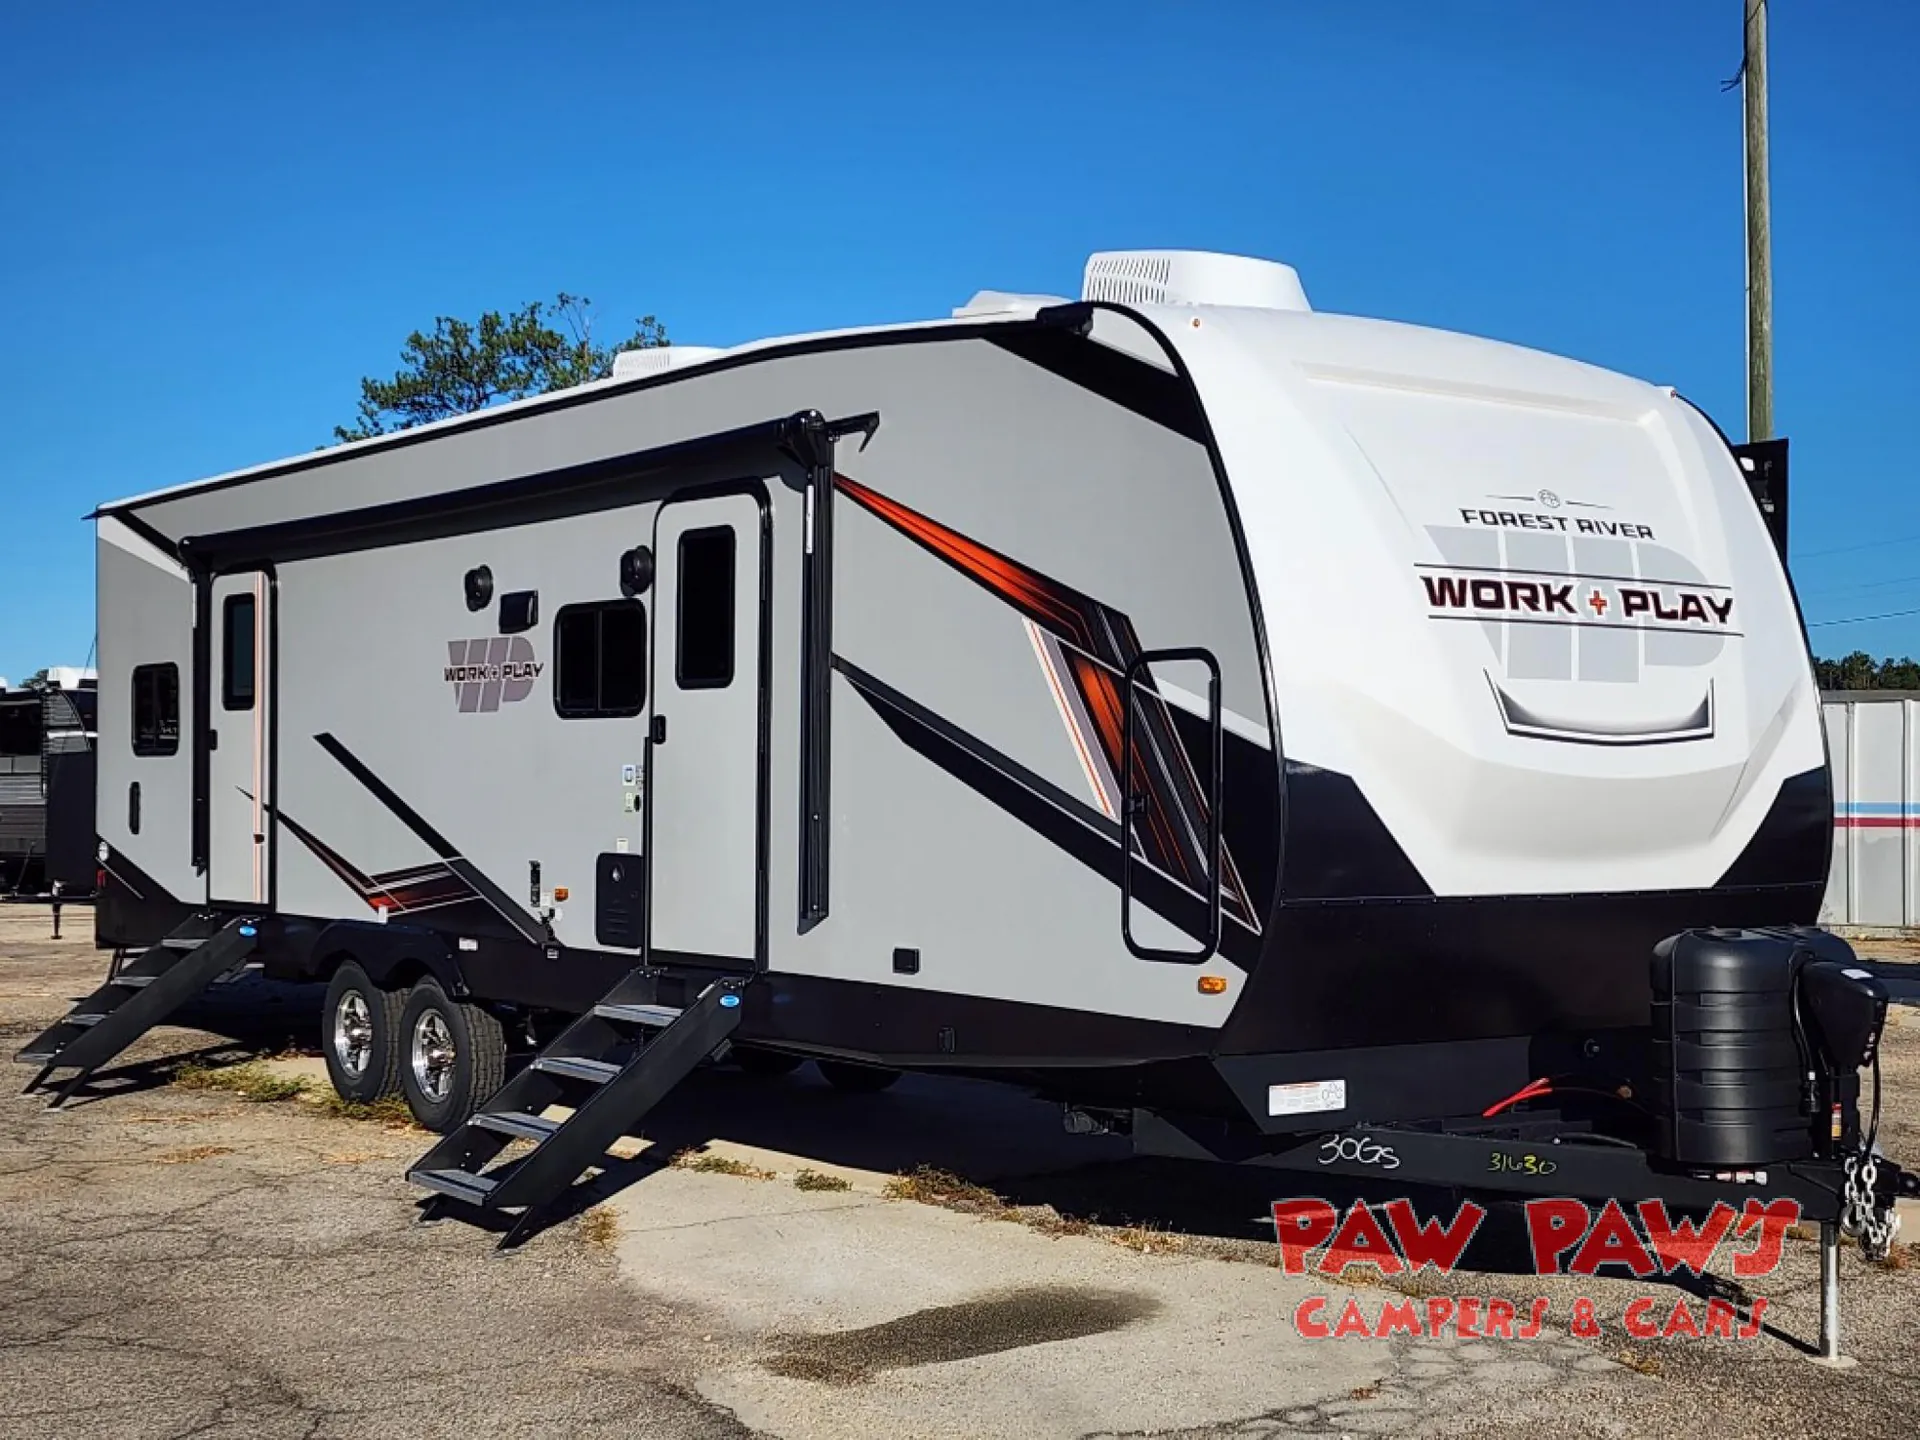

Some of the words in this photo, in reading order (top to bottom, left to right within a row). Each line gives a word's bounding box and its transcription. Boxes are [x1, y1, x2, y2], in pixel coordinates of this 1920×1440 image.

[1459, 507, 1568, 533] FOREST
[1575, 518, 1656, 540] RIVER
[1419, 576, 1578, 614] WORK
[1617, 588, 1734, 624] PLAY
[444, 667, 488, 681] WORK
[503, 662, 544, 678] PLAY
